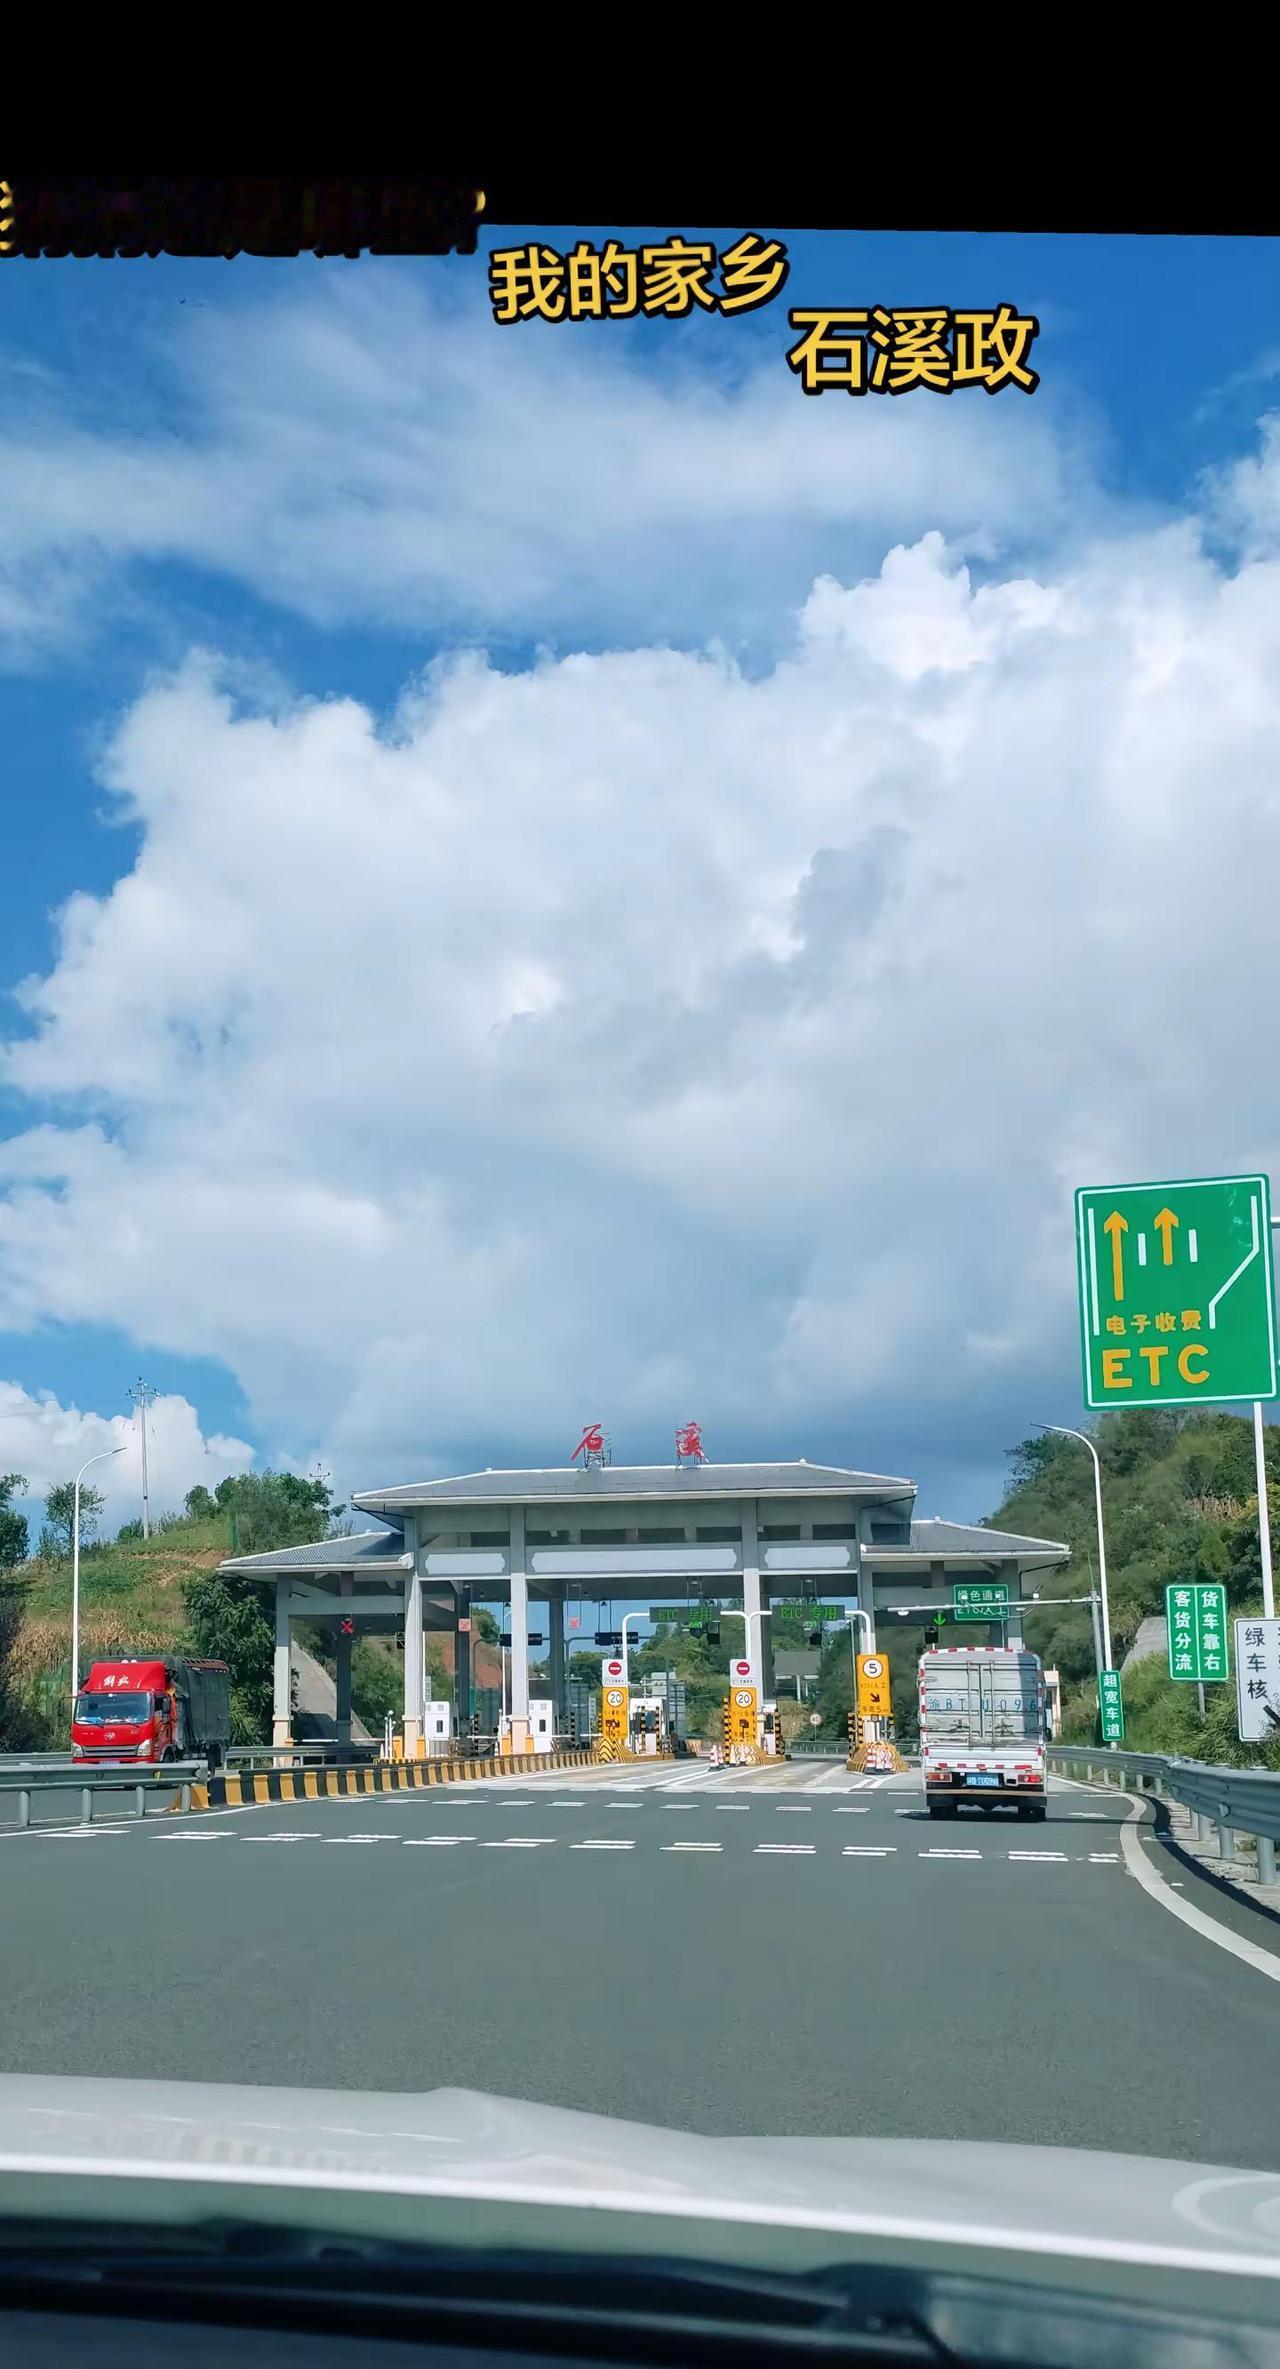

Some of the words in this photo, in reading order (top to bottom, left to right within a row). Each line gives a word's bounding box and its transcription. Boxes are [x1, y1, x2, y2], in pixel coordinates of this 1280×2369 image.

[1105, 1309, 1202, 1336] 电子收费
[1101, 1343, 1211, 1389] ETC
[1174, 1590, 1193, 1671] 客货分流
[1201, 1591, 1221, 1671] 货车靠右
[868, 1663, 878, 1674] 5
[610, 1693, 622, 1704] 20
[738, 1694, 750, 1704] 20
[1102, 1674, 1121, 1737] 超宽车道
